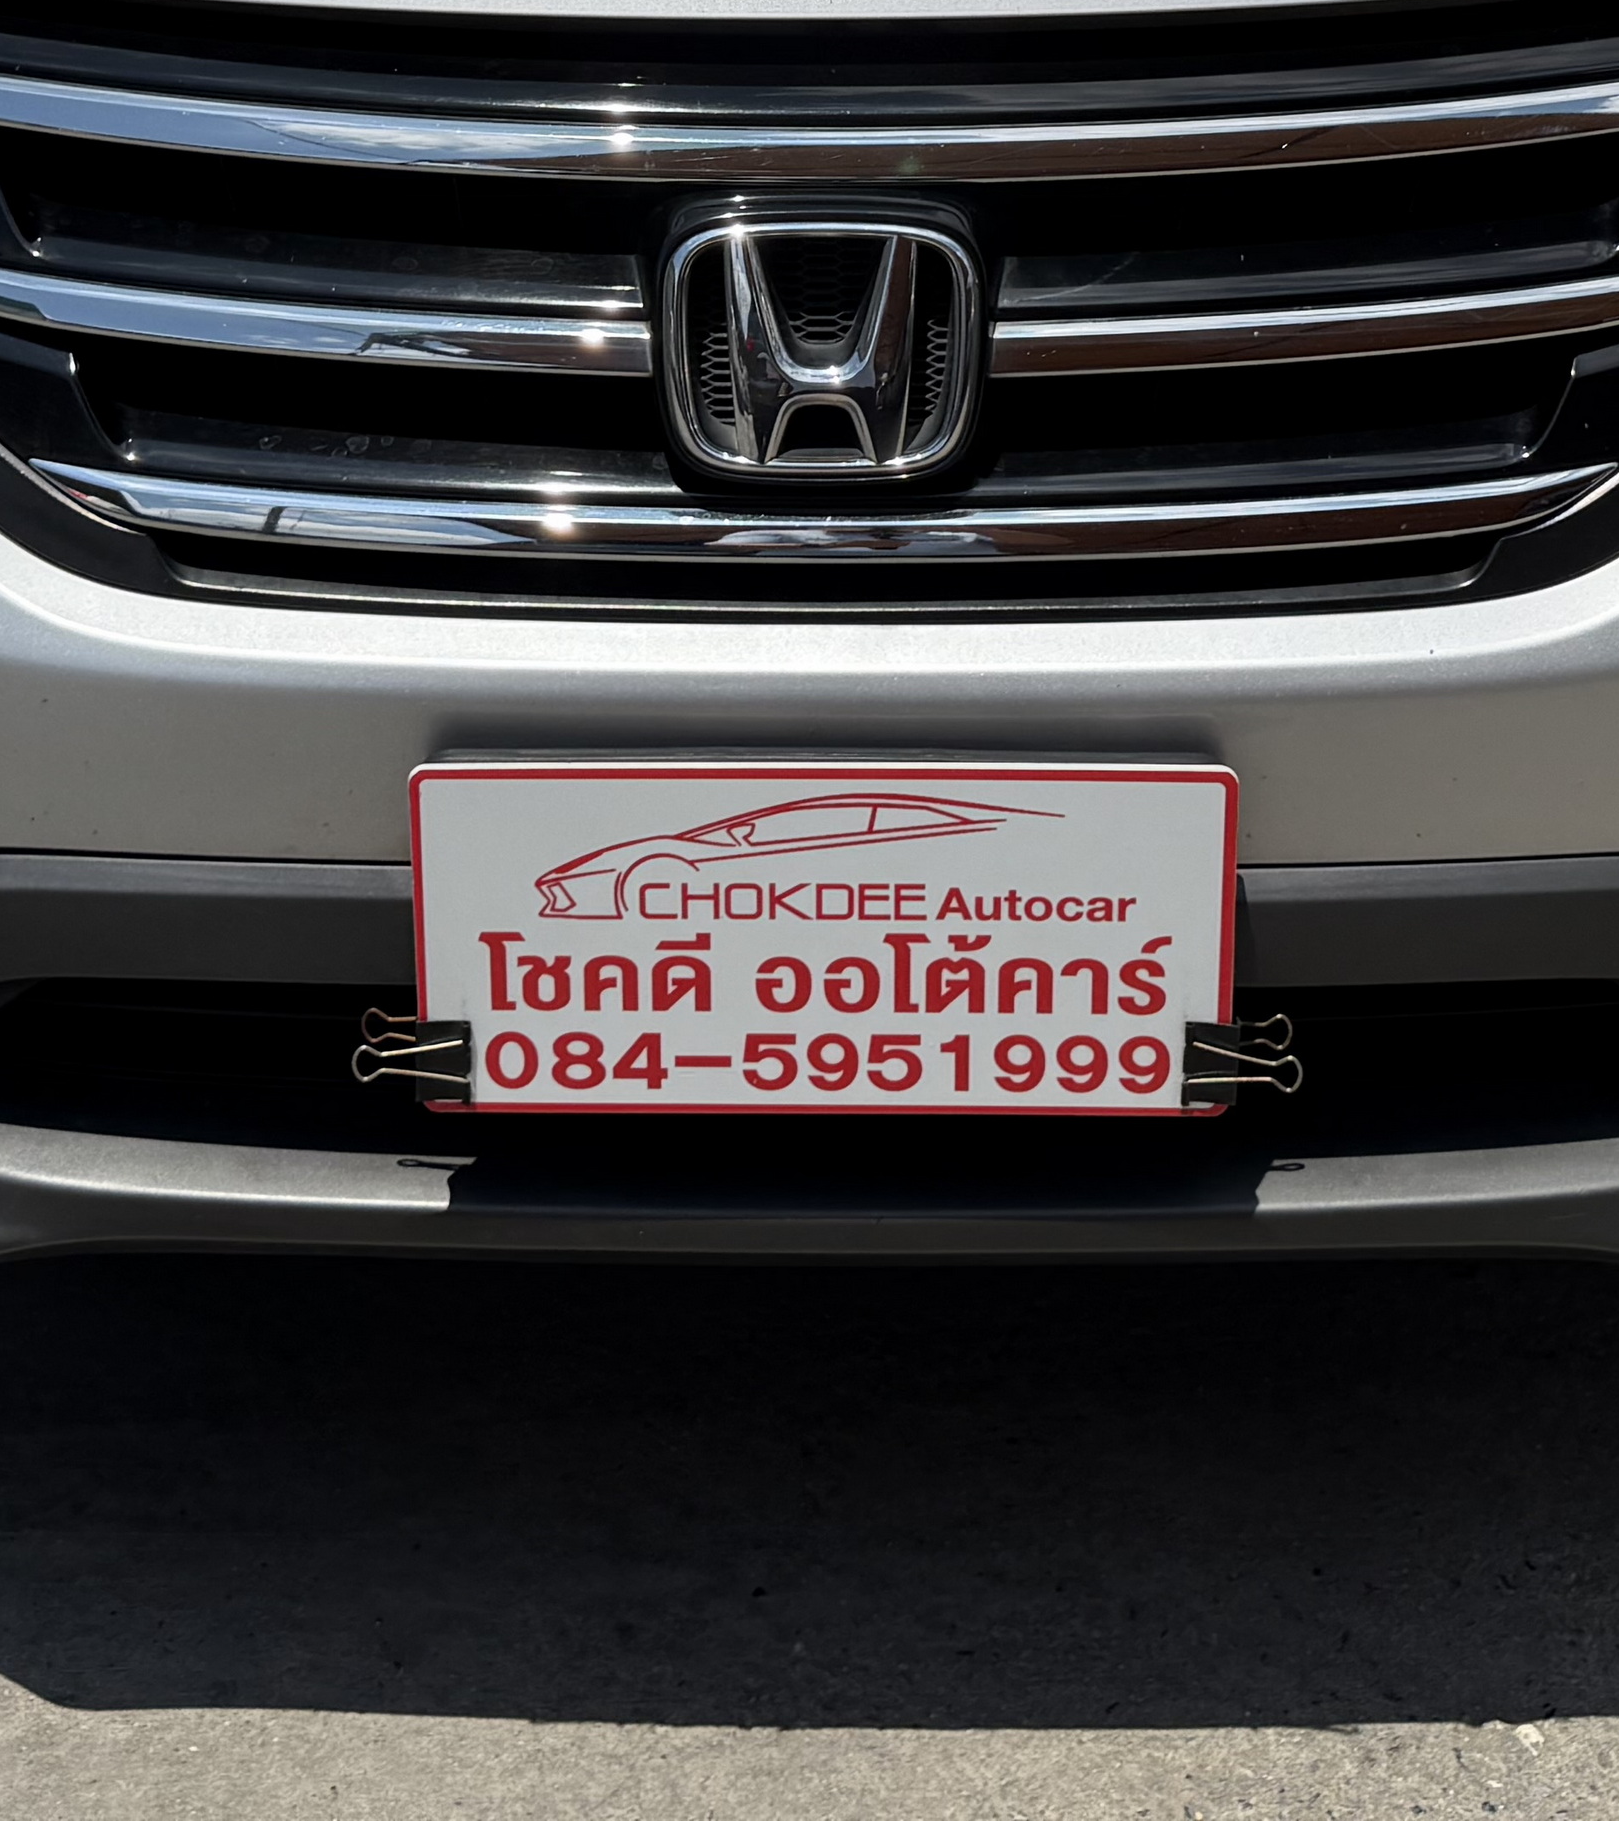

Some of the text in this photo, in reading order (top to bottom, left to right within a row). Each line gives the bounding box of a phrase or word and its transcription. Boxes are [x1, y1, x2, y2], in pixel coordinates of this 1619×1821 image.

[638, 882, 1138, 923] CHOKDEE Autocar
[478, 931, 1173, 1016] โชคดี ออโต้คาร์
[483, 1030, 1172, 1093] 084-5951999
